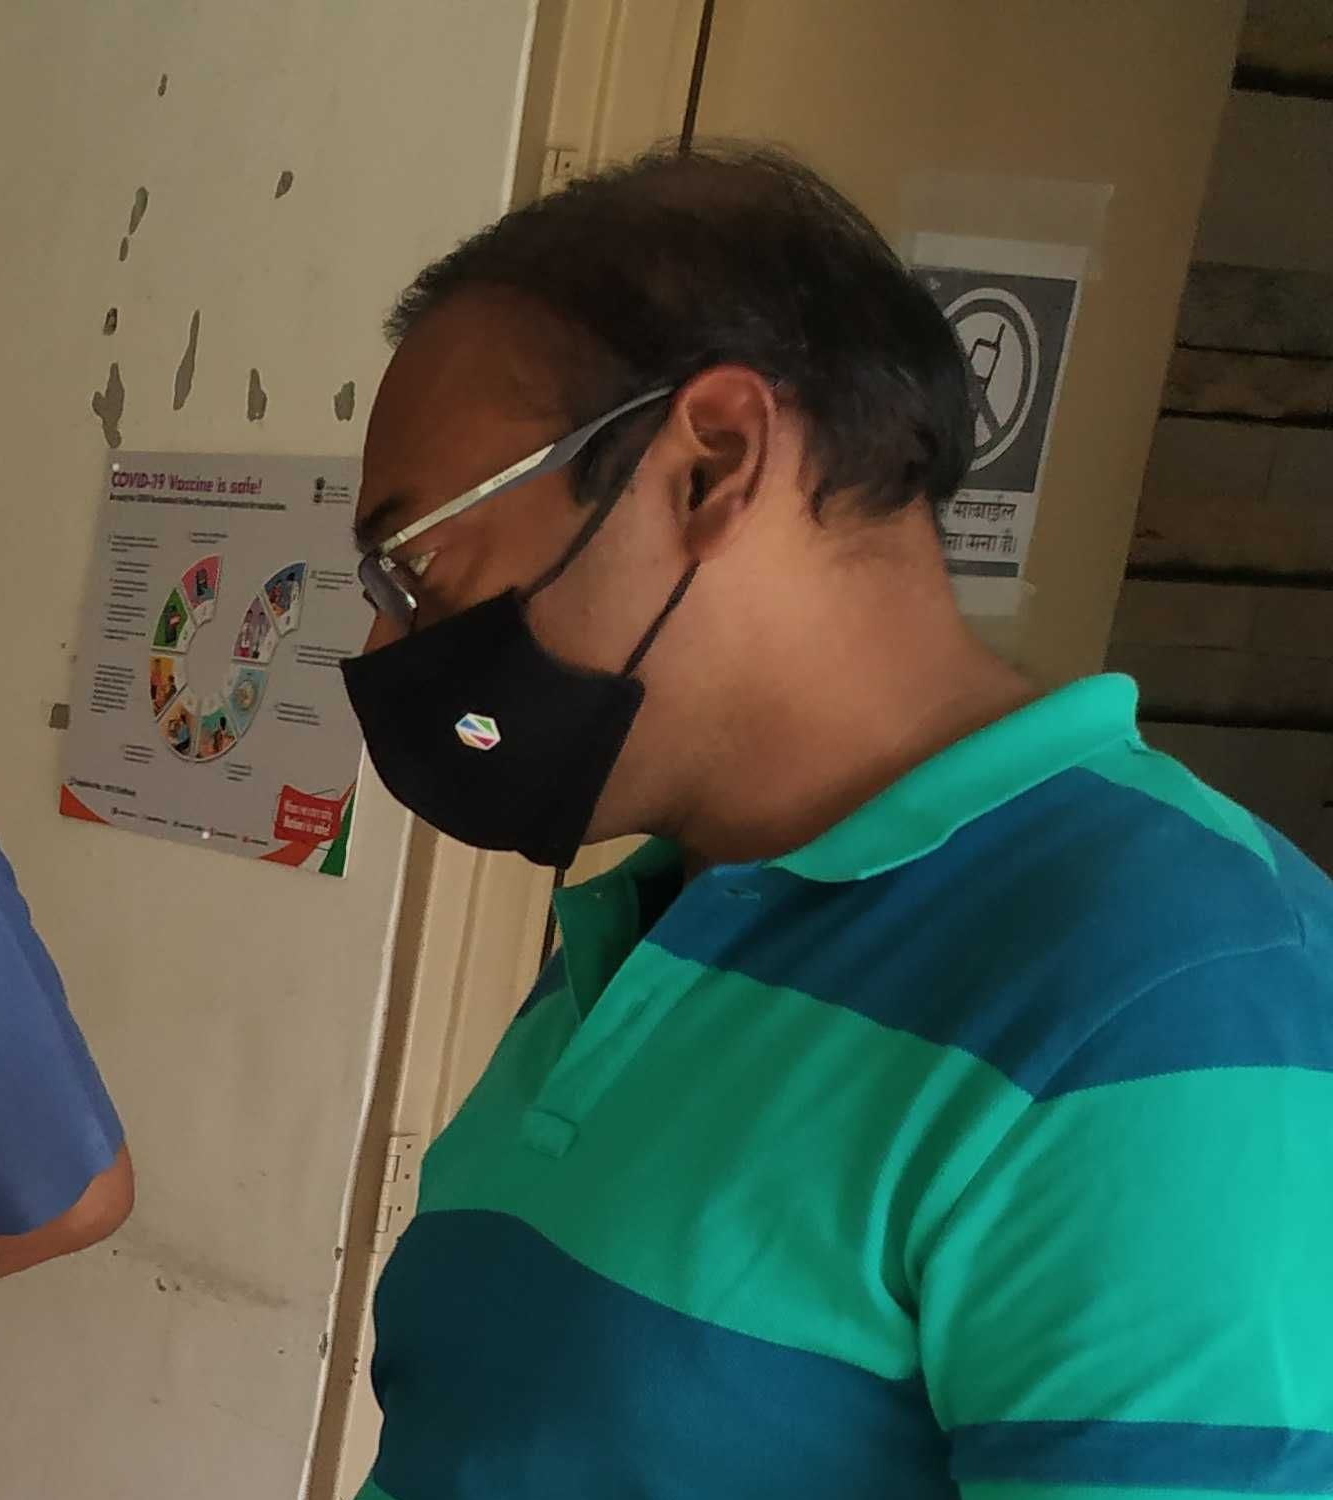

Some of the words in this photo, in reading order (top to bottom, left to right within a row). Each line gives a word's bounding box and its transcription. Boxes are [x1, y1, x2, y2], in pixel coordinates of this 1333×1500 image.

[111, 471, 165, 490] COVID-19
[169, 474, 214, 493] Vaccine
[216, 476, 226, 494] is
[229, 476, 263, 495] safe!
